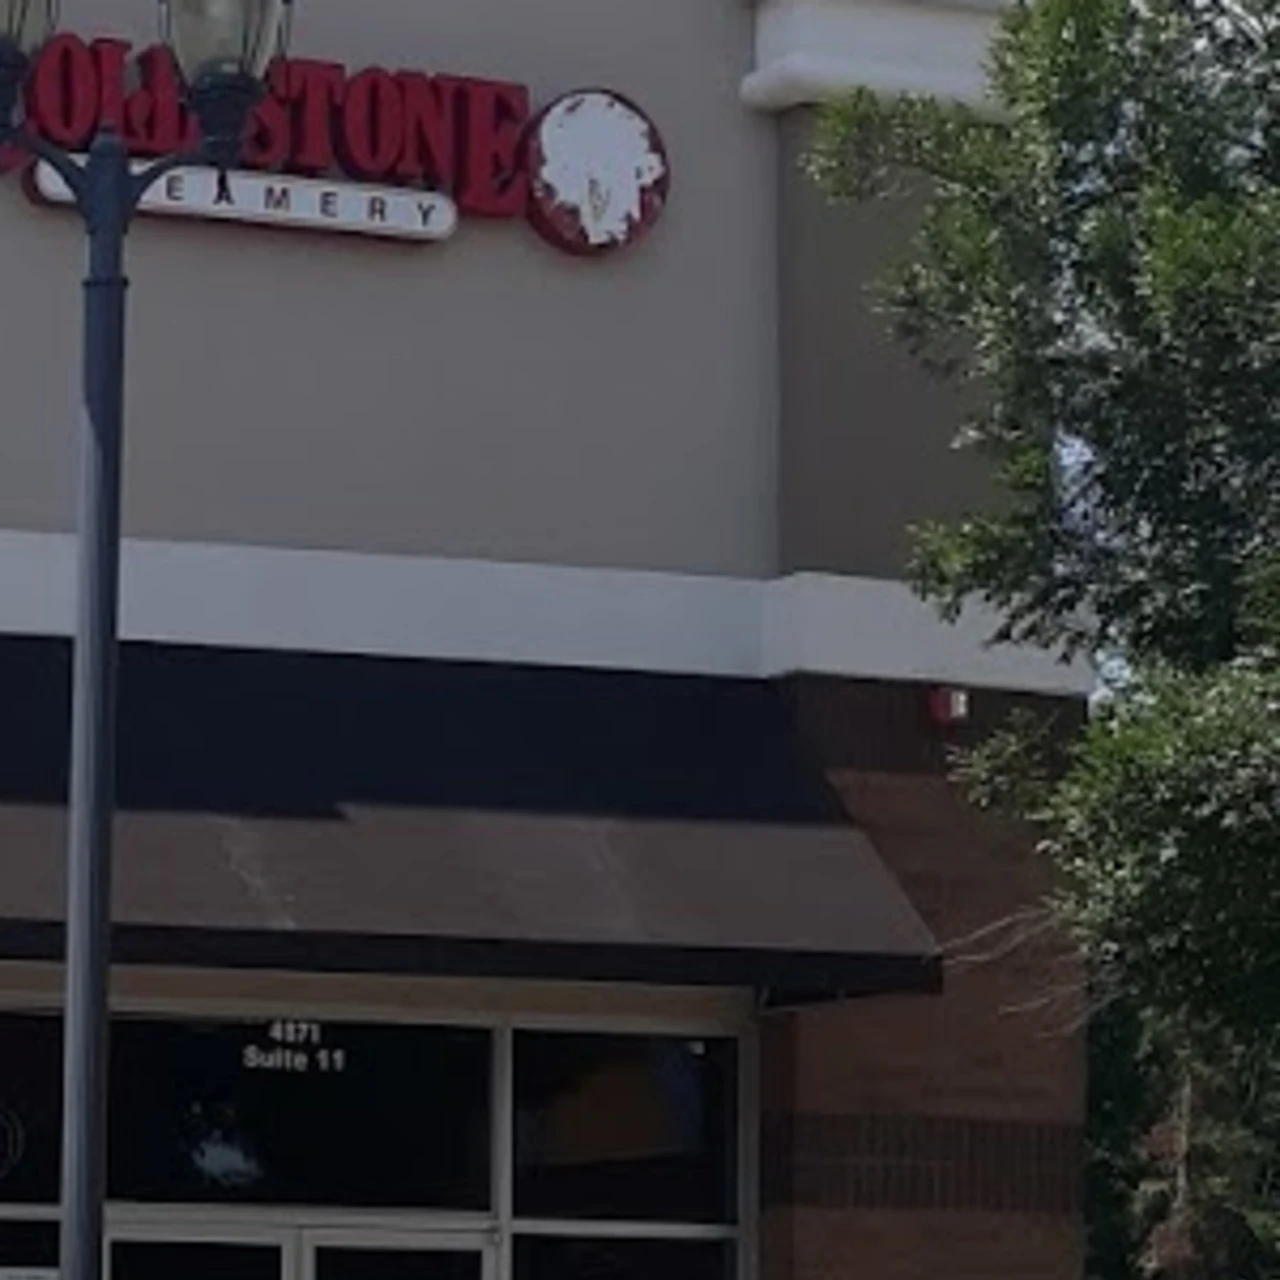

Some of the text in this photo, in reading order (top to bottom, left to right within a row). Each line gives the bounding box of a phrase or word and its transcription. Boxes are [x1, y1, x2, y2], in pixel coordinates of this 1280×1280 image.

[242, 57, 531, 217] STONE
[164, 167, 440, 228] EAMERY
[242, 1043, 344, 1072] Suite 11
